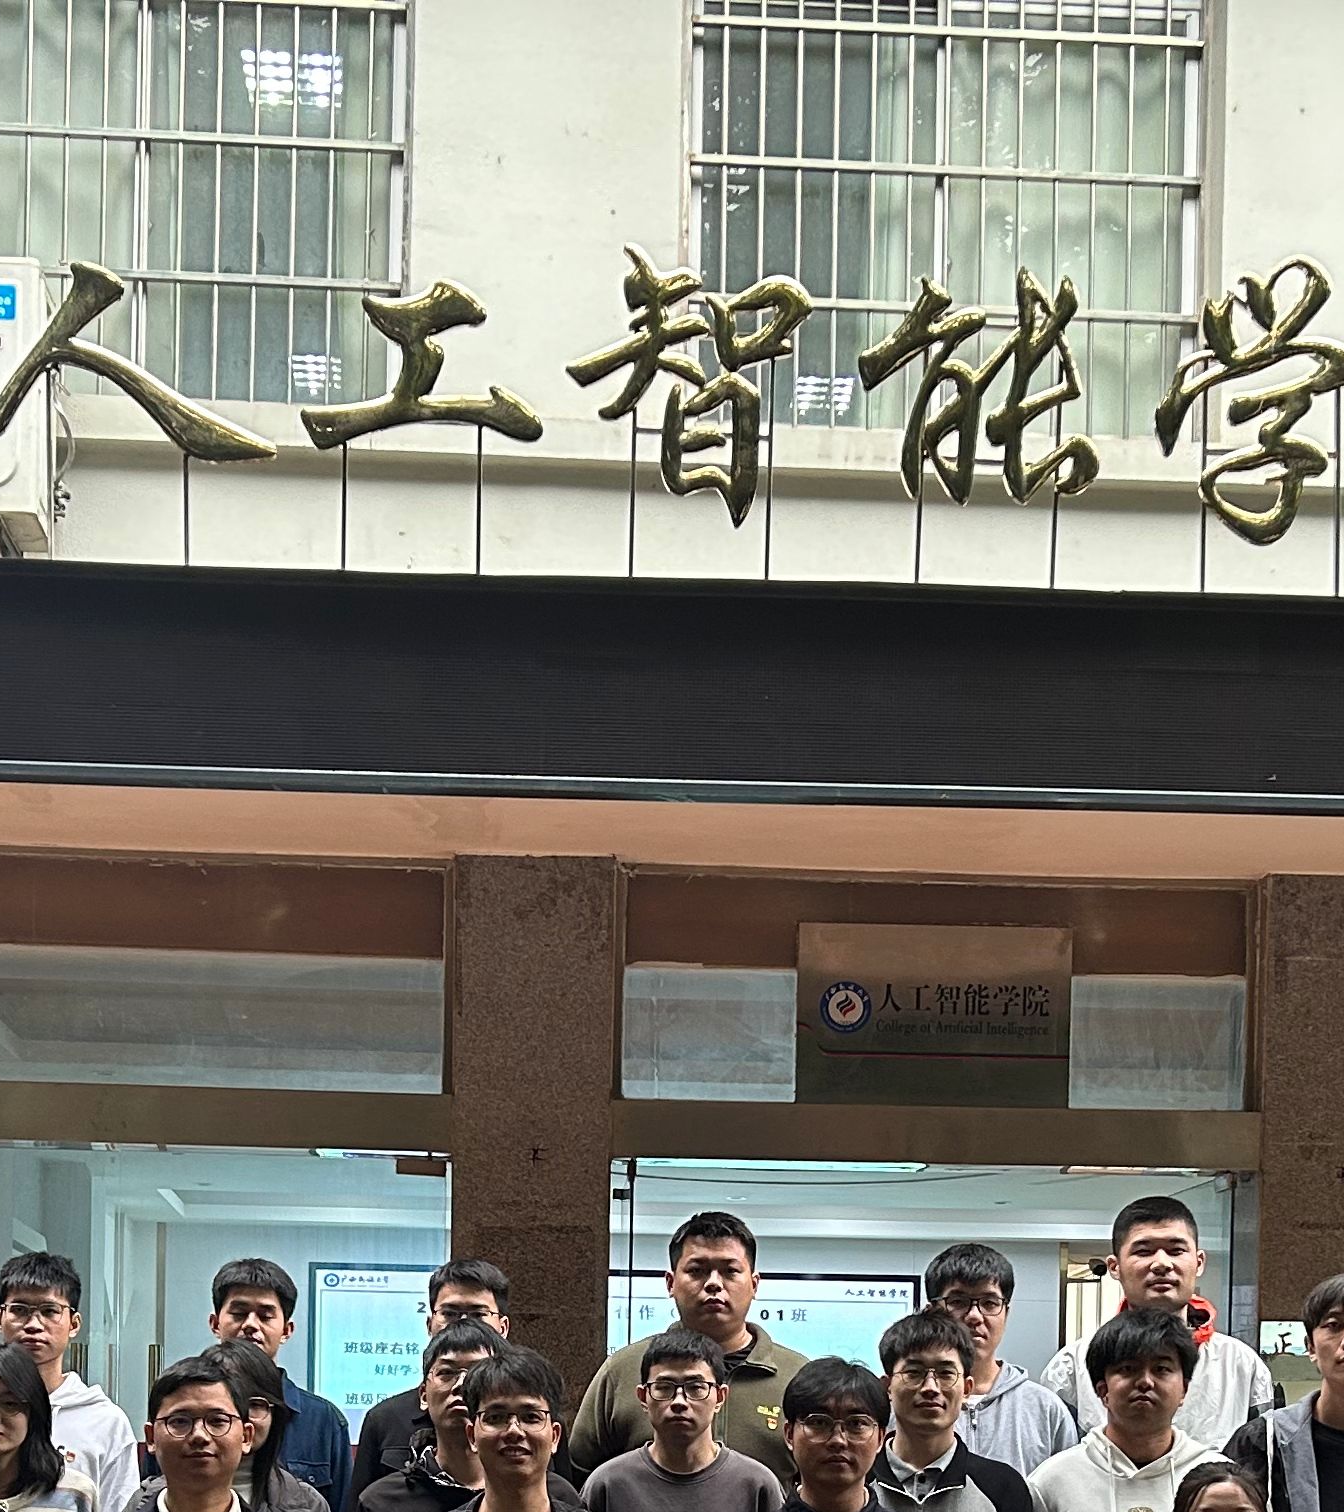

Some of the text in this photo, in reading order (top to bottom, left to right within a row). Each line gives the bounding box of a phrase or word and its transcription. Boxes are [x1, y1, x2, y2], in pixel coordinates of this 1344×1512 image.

[878, 983, 1051, 1018] 人工智能学院
[876, 1018, 918, 1037] College
[986, 1021, 1050, 1040] Intelligence
[344, 1341, 420, 1355] 班级座右铭
